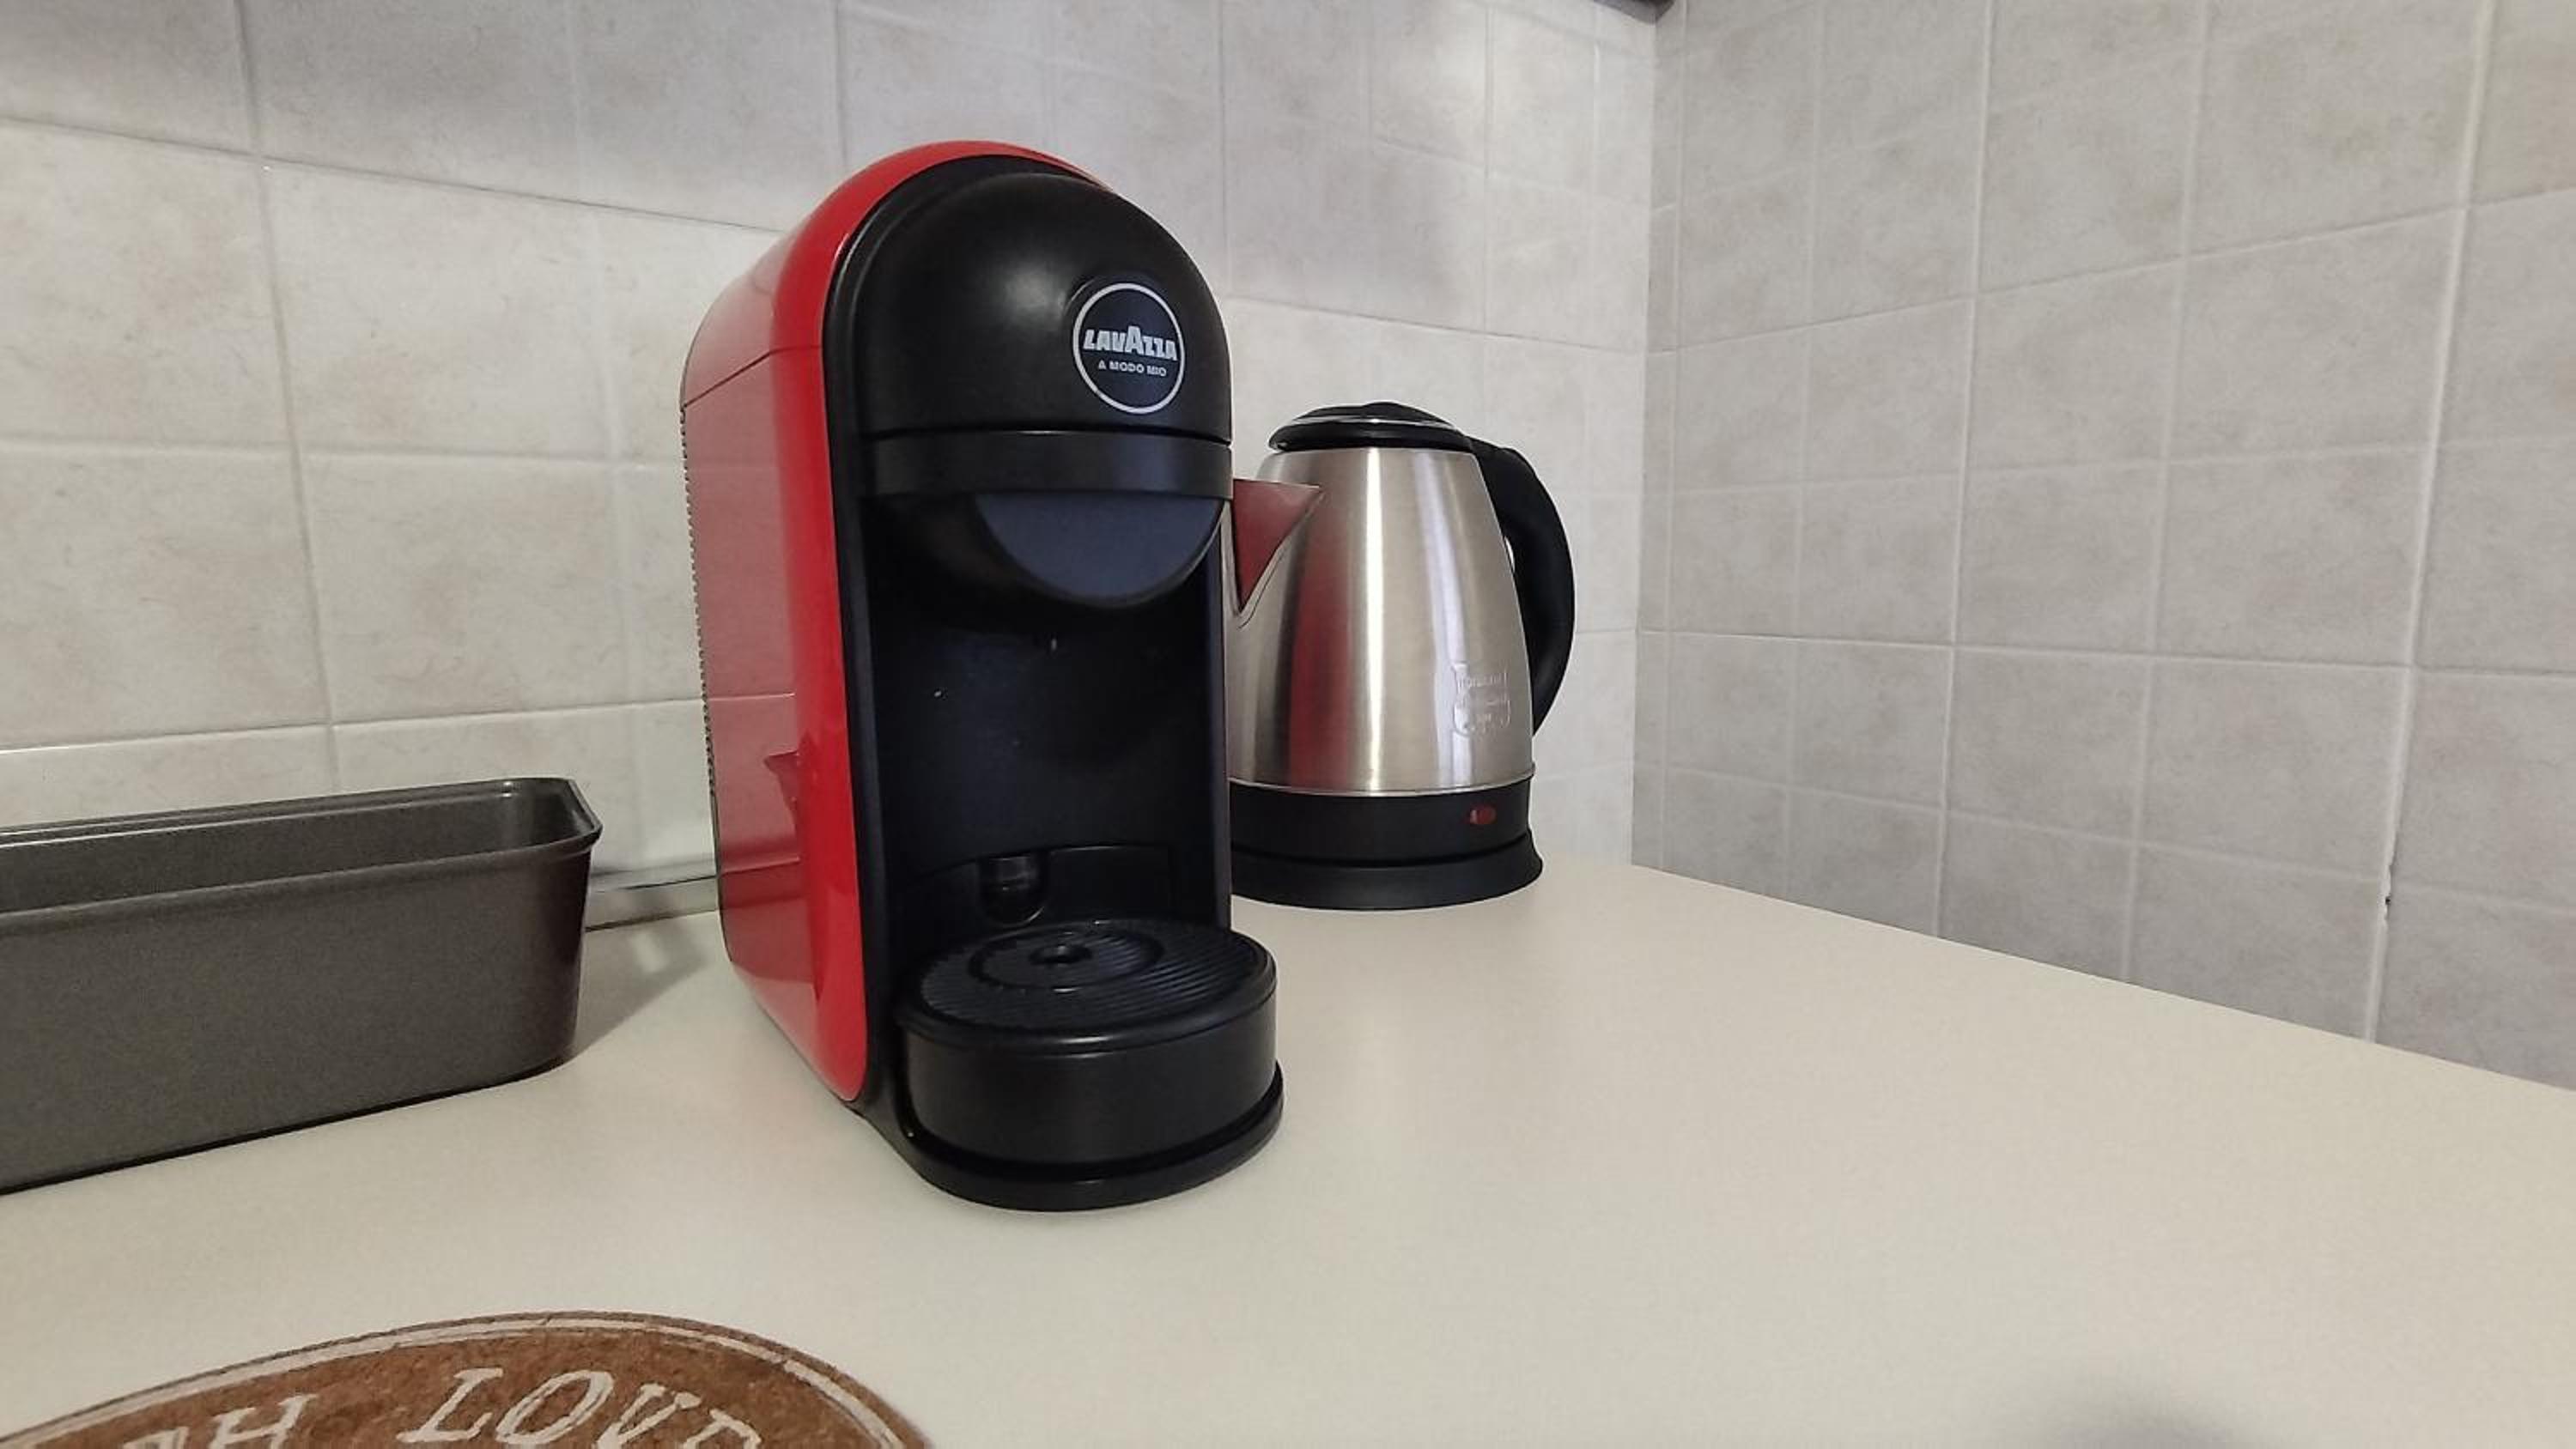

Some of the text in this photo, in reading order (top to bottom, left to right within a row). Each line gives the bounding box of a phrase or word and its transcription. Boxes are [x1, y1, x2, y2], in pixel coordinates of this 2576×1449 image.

[1083, 325, 1177, 361] LAVAZZA
[1098, 360, 1166, 377] A MODO MIO
